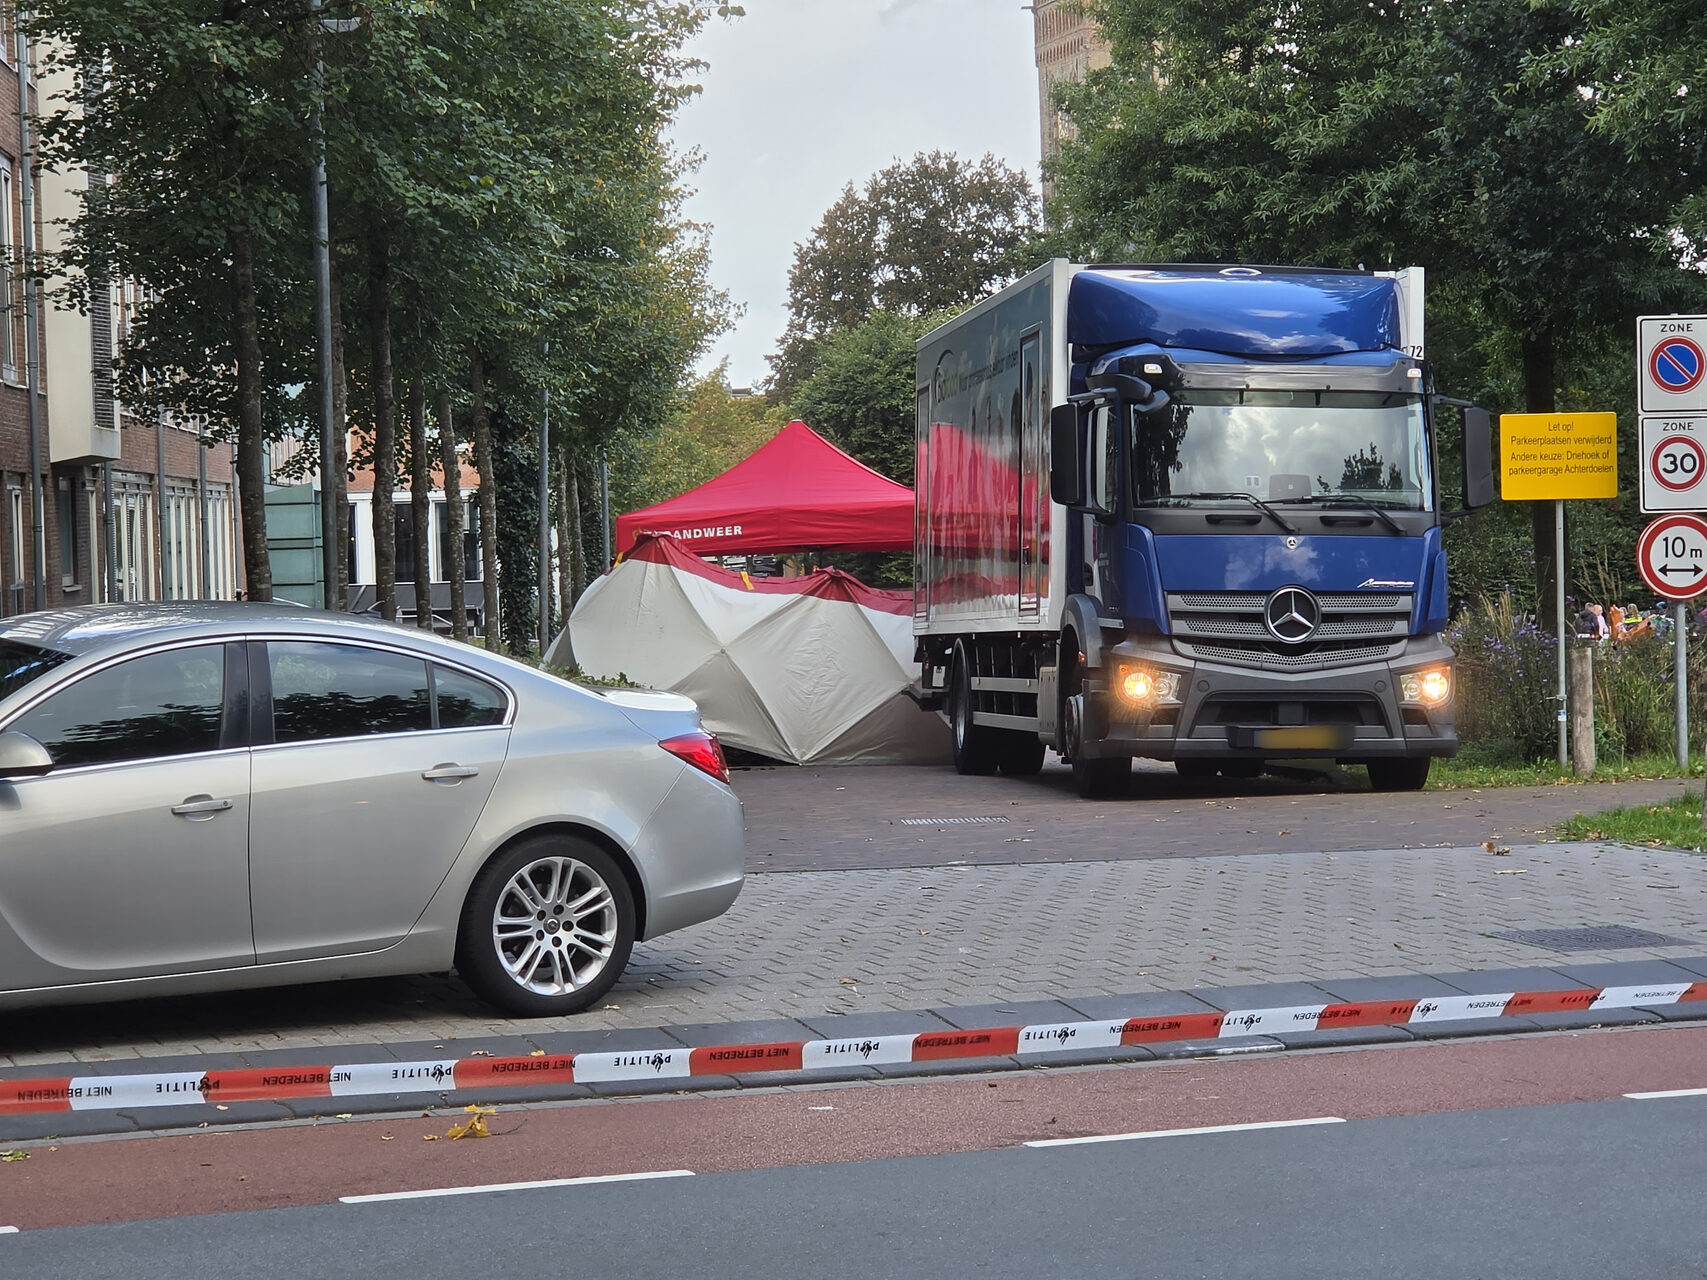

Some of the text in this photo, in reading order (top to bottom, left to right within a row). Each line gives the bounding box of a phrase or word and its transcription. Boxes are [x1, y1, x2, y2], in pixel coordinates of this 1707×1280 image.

[1660, 323, 1693, 332] ZONE
[1548, 421, 1574, 433] Let op!
[1662, 422, 1694, 431] ZONE
[1510, 435, 1612, 446] Parkeerplaatsen verwijderd
[1511, 449, 1610, 461] Andere keuze: Driehoek of
[1662, 453, 1697, 473] 30
[1508, 464, 1614, 477] parkeergarage Achterdoelen
[654, 526, 743, 540] ANDWEER
[1662, 536, 1702, 558] 10 m
[1109, 1021, 1181, 1033] NIET BETREDEN
[709, 1047, 790, 1060] NIET BETREDEN
[491, 1060, 576, 1073] NIET BETREDEN
[262, 1071, 351, 1087] NIET BETREDEN
[86, 1086, 112, 1097] NIET
